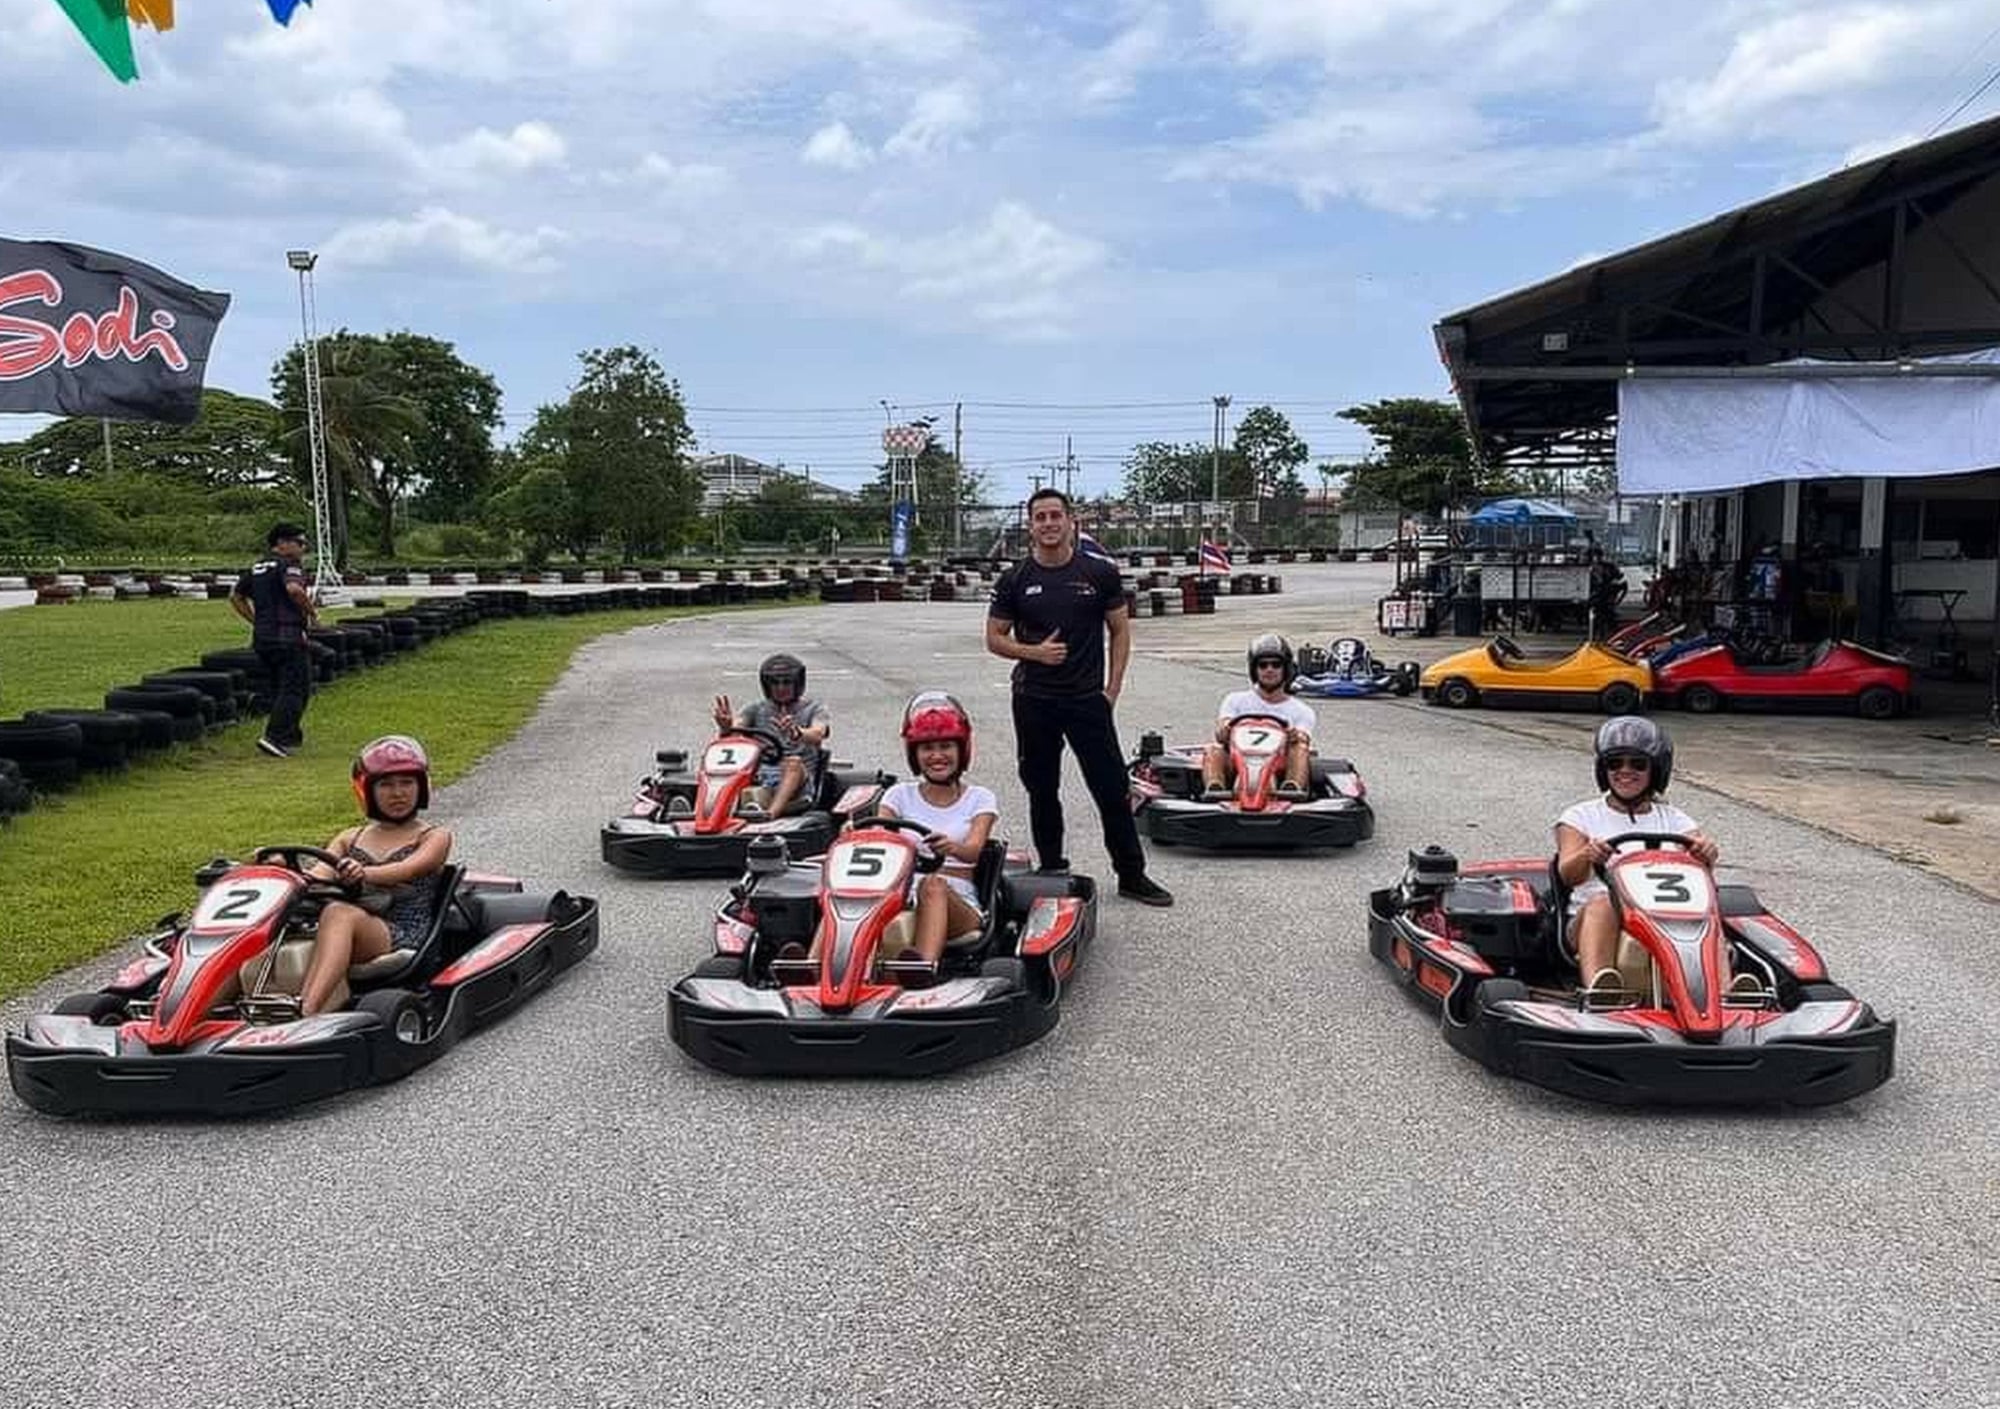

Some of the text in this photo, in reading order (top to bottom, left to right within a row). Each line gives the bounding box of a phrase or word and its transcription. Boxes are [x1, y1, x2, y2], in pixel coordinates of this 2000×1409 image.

[0, 269, 189, 381] Sodi
[1248, 730, 1269, 746] 7
[717, 748, 737, 765] 1
[846, 847, 886, 877] 5
[1645, 872, 1690, 903] 3
[212, 889, 262, 920] 2
